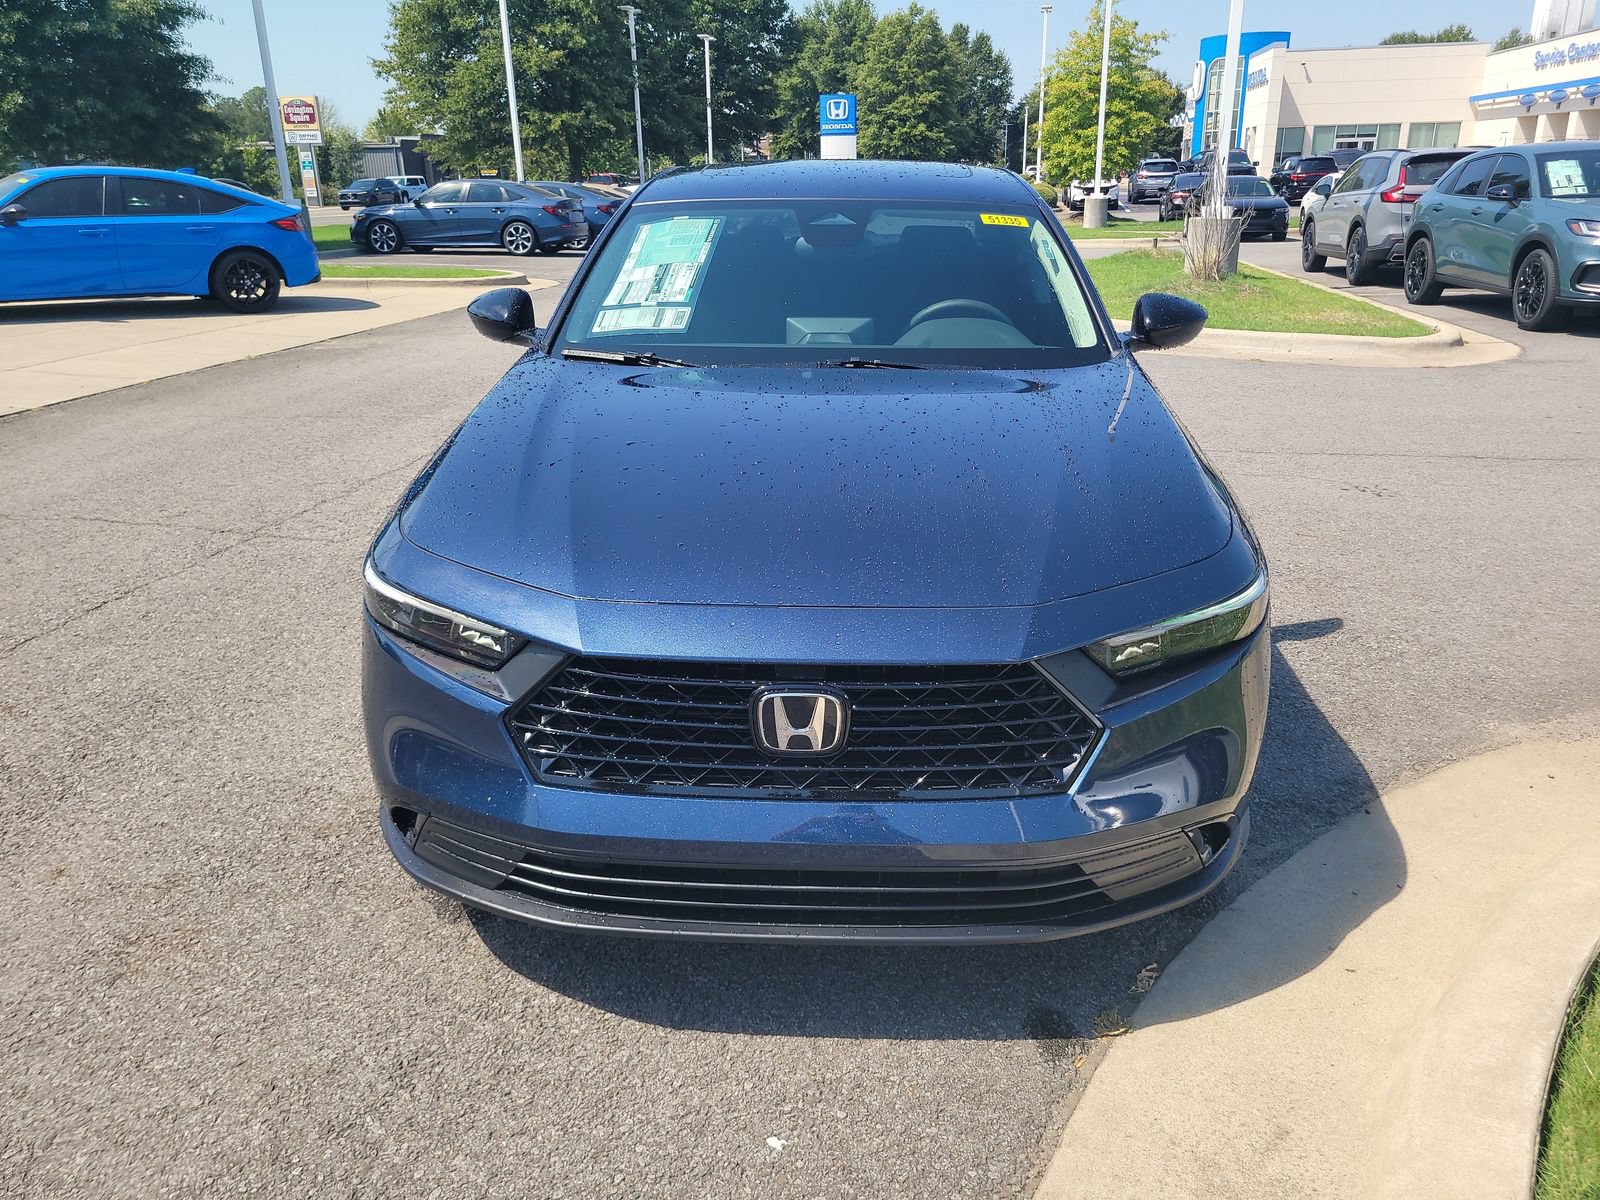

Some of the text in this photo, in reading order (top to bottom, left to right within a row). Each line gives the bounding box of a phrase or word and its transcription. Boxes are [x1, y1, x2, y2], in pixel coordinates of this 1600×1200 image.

[1535, 50, 1567, 67] Service
[284, 104, 314, 115] Covington
[290, 113, 310, 123] Square
[988, 216, 1022, 226] 51335
